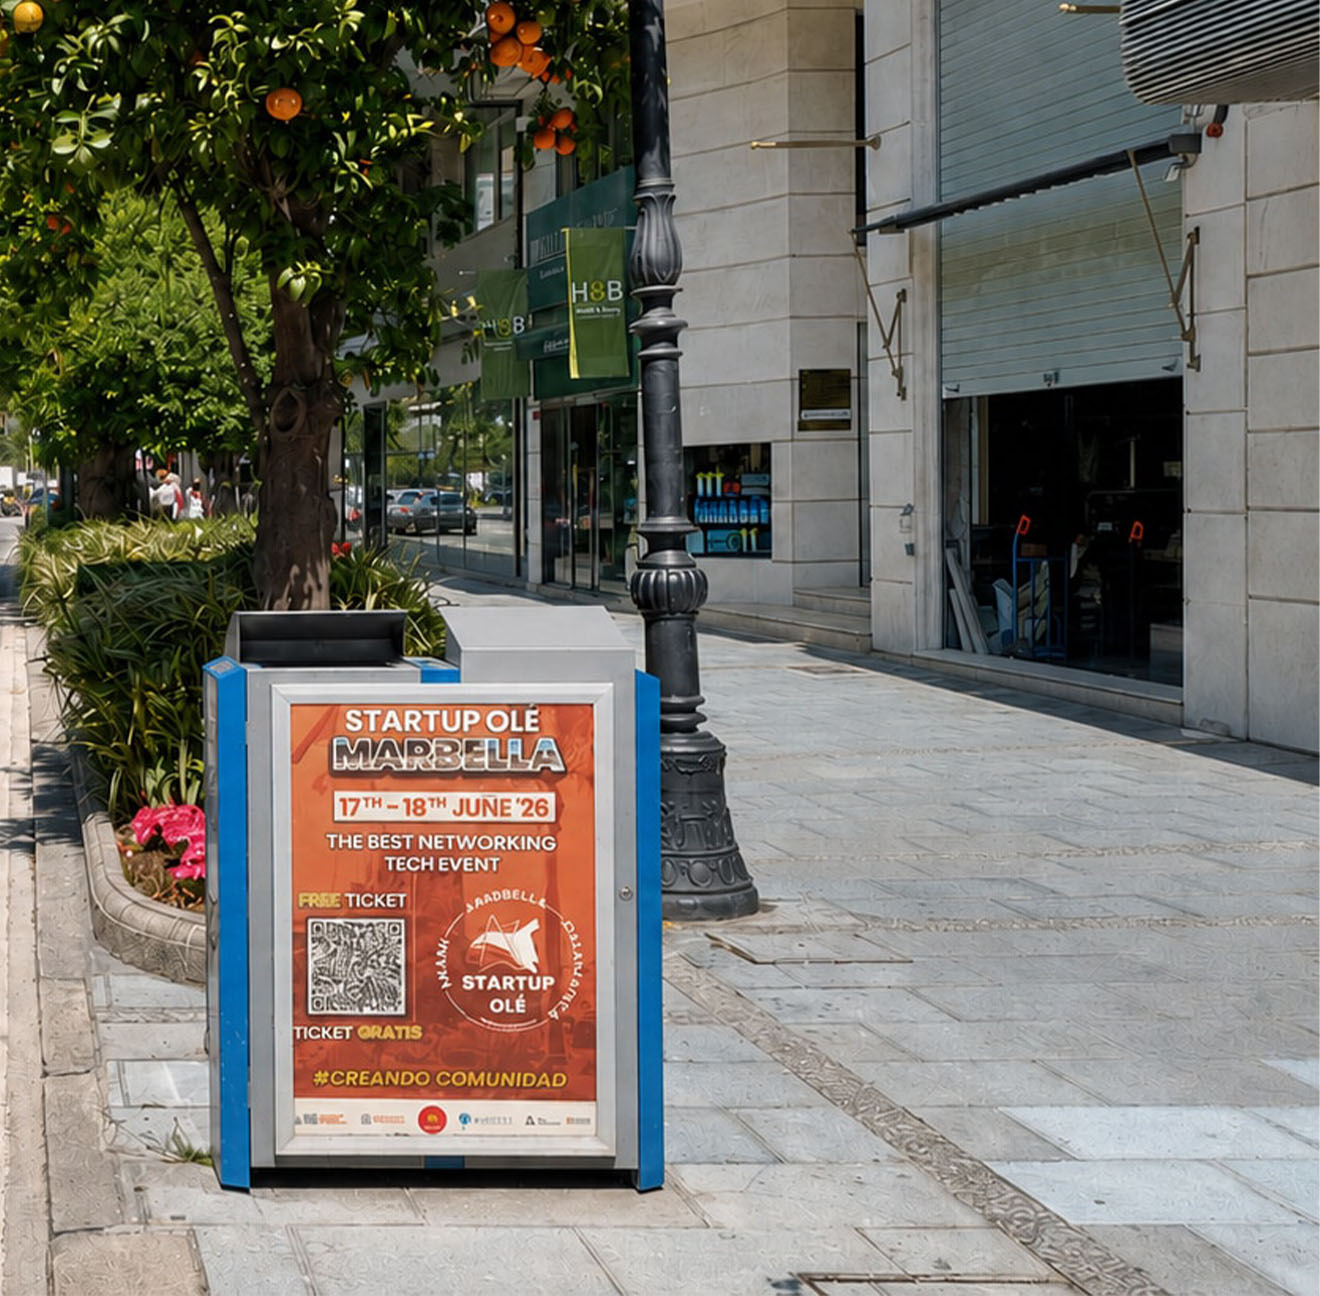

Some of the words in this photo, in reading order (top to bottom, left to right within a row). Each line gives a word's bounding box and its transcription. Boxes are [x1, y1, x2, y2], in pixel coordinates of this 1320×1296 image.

[345, 709, 480, 733] STARTUP
[486, 704, 539, 733] OLÉ
[332, 737, 566, 773] MARBELLA
[339, 796, 382, 817] 17TH
[403, 796, 446, 817] 18TH
[452, 798, 511, 817] JUNE
[326, 834, 363, 850] THE
[368, 834, 413, 850] BEST
[418, 835, 557, 851] NETWORKING
[384, 856, 434, 872] TECH
[438, 857, 500, 872] EVENT
[298, 892, 341, 908] FREE
[344, 893, 407, 908] TICKET
[462, 975, 556, 991] STARTUP
[490, 994, 526, 1013] OLÉ
[294, 1026, 353, 1040] TICKET
[357, 1025, 423, 1040] GRATIS
[313, 1070, 430, 1087] #CREANDO
[436, 1071, 567, 1088] COMUNIDAD
